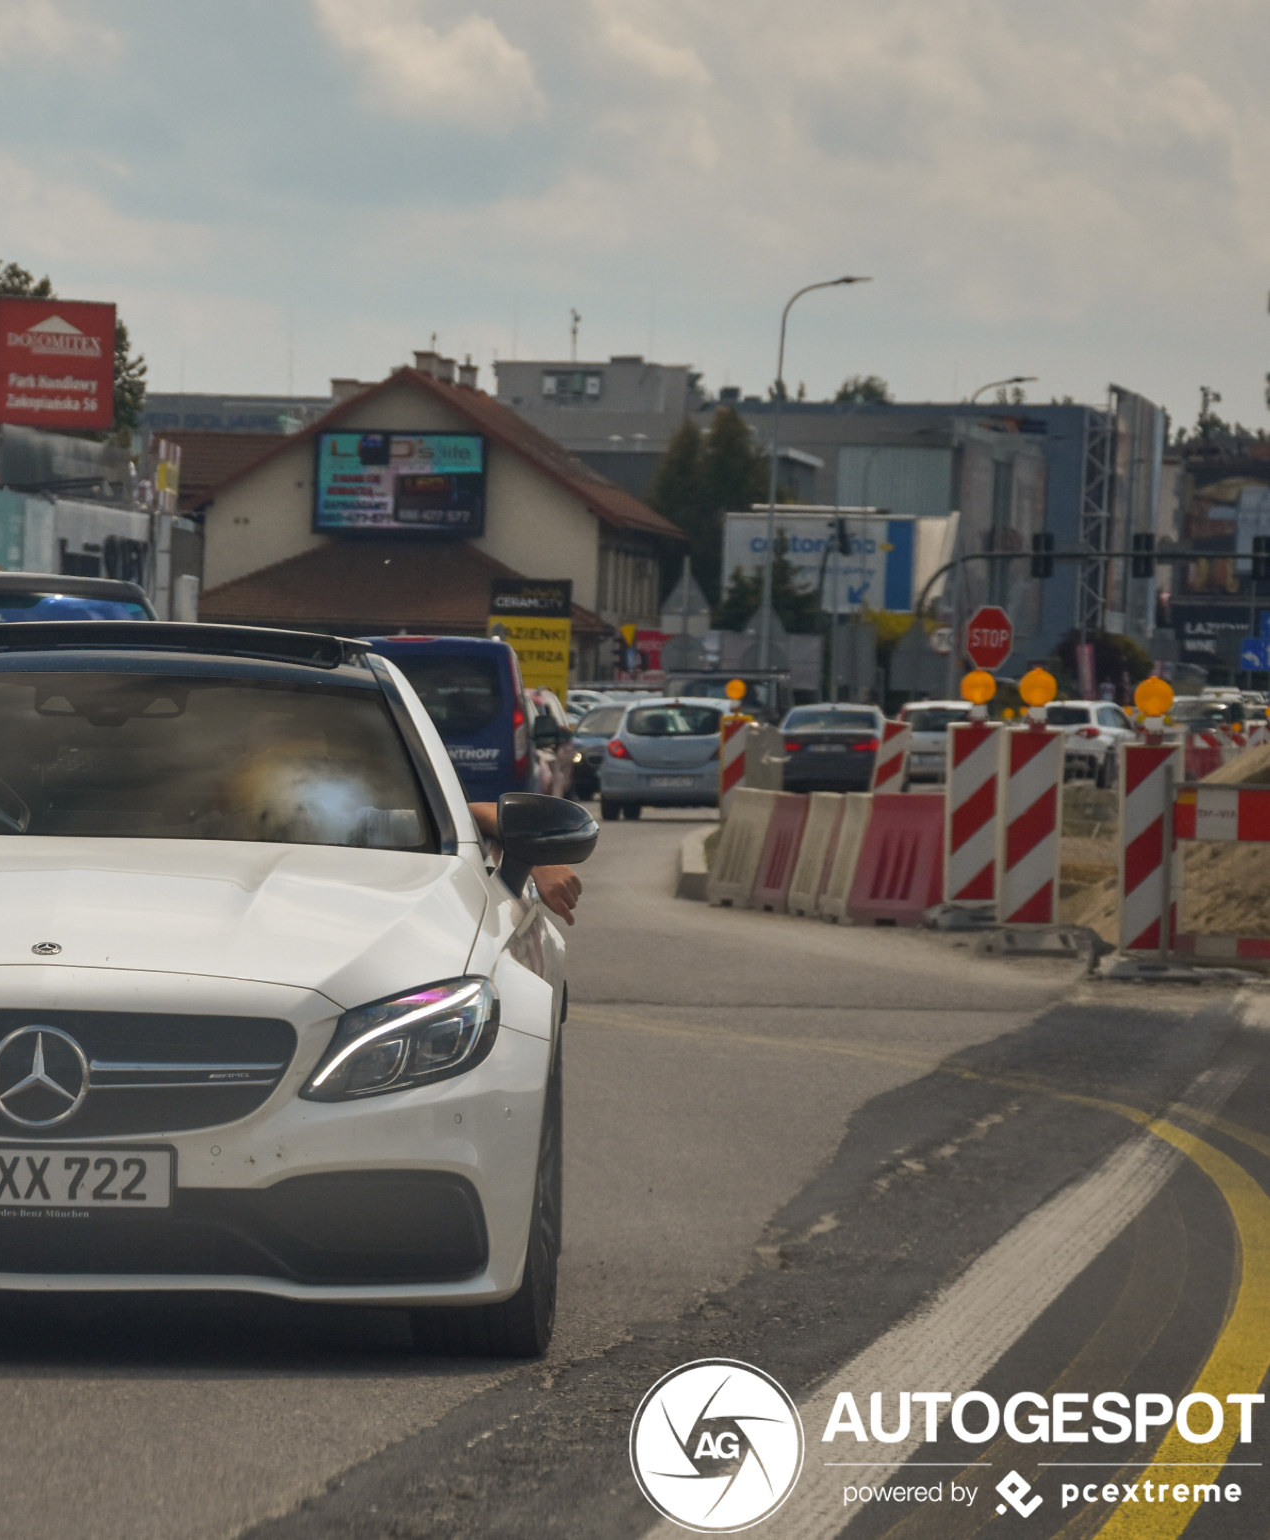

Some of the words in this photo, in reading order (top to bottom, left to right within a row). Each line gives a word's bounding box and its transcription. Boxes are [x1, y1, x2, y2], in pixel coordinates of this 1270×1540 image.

[8, 372, 35, 388] Park
[38, 375, 98, 394] Handlowy
[506, 627, 568, 640] AZIENKI
[971, 628, 1009, 648] STOP
[448, 748, 500, 760] NTHOFF
[64, 1156, 147, 1200] 722
[45, 1208, 90, 1218] München
